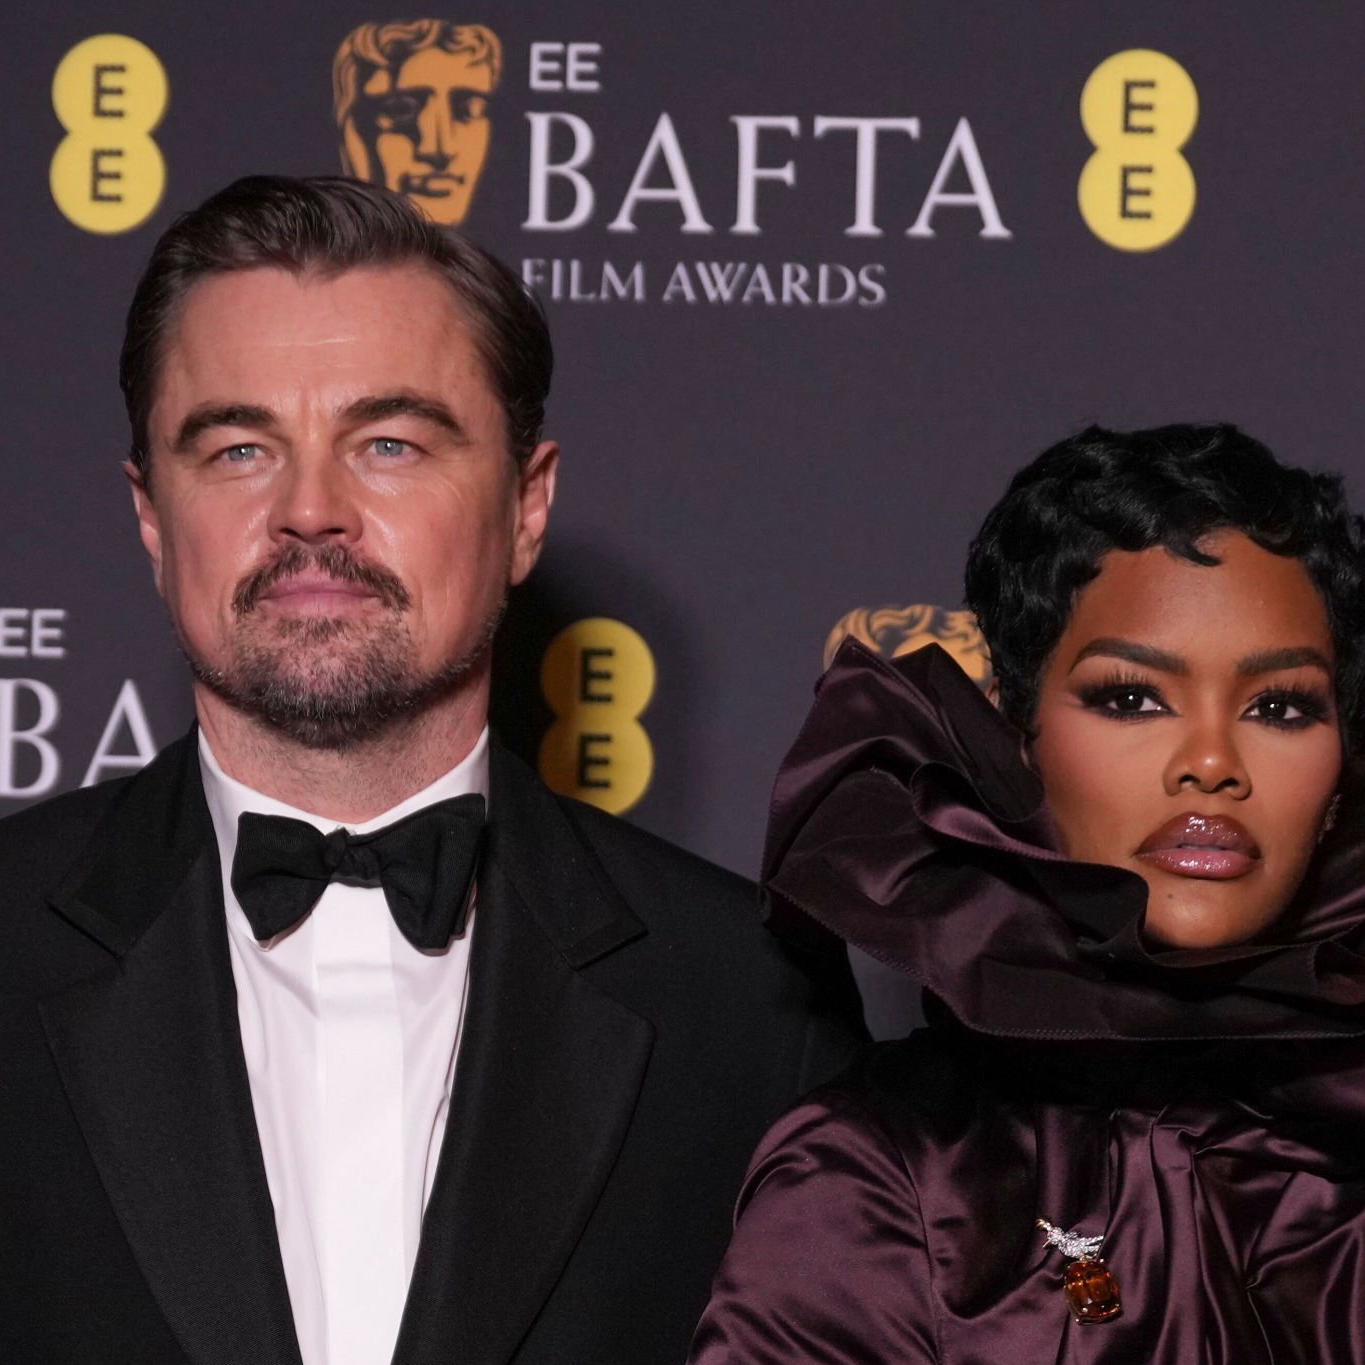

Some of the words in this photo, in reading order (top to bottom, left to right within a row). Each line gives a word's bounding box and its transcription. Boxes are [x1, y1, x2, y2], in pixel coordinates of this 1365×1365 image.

[530, 43, 600, 91] EE
[522, 112, 1012, 238] BAFTA
[523, 259, 644, 301] FILM
[664, 262, 885, 304] AWARDS
